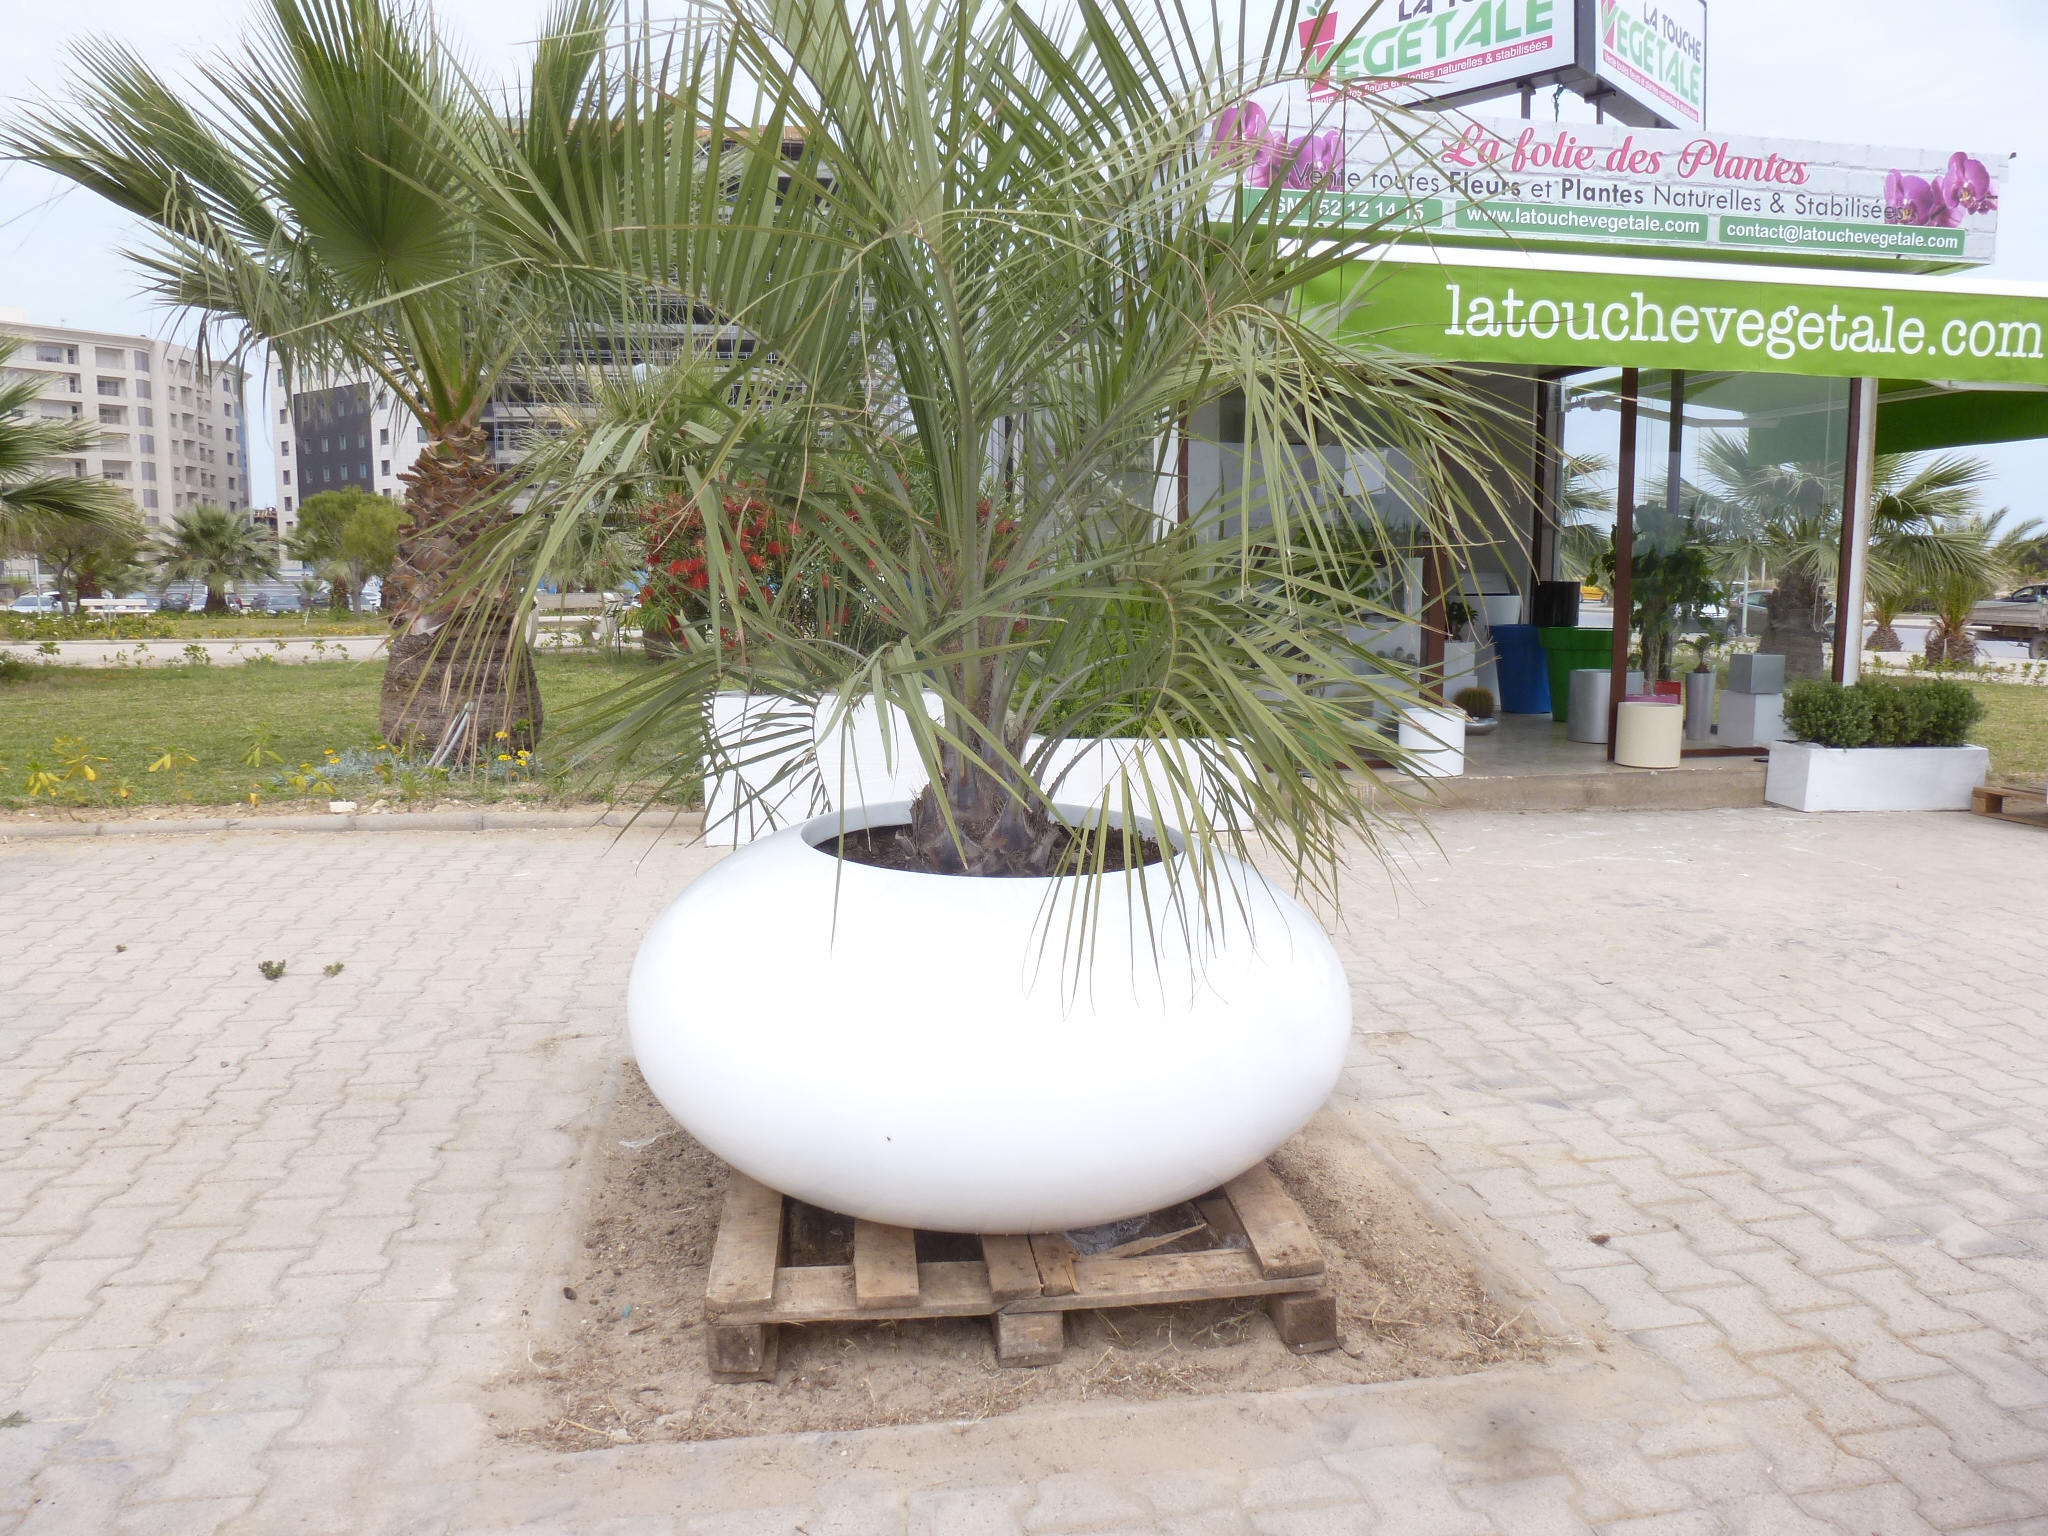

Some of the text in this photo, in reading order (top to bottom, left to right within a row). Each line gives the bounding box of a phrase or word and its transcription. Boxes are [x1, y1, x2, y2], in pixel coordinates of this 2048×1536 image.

[1437, 57, 1483, 76] naturelles
[1495, 39, 1548, 61] stabilisées
[1602, 0, 1702, 106] VEGETALE
[1643, 1, 1702, 63] LA TOUCHE
[1441, 123, 1811, 185] La folie des Plantes
[1292, 162, 1903, 221] Vente toutes Fleurs et Plantes Naturelles & Stabilisées
[1318, 199, 1342, 216] 52
[1347, 200, 1369, 218] 12
[1375, 202, 1398, 219] 14
[1466, 207, 1700, 234] www.latouchevegetale.com
[1726, 222, 1958, 249] contact@latouchevegetale.com
[1444, 284, 2044, 360] latouchevegetale.com
